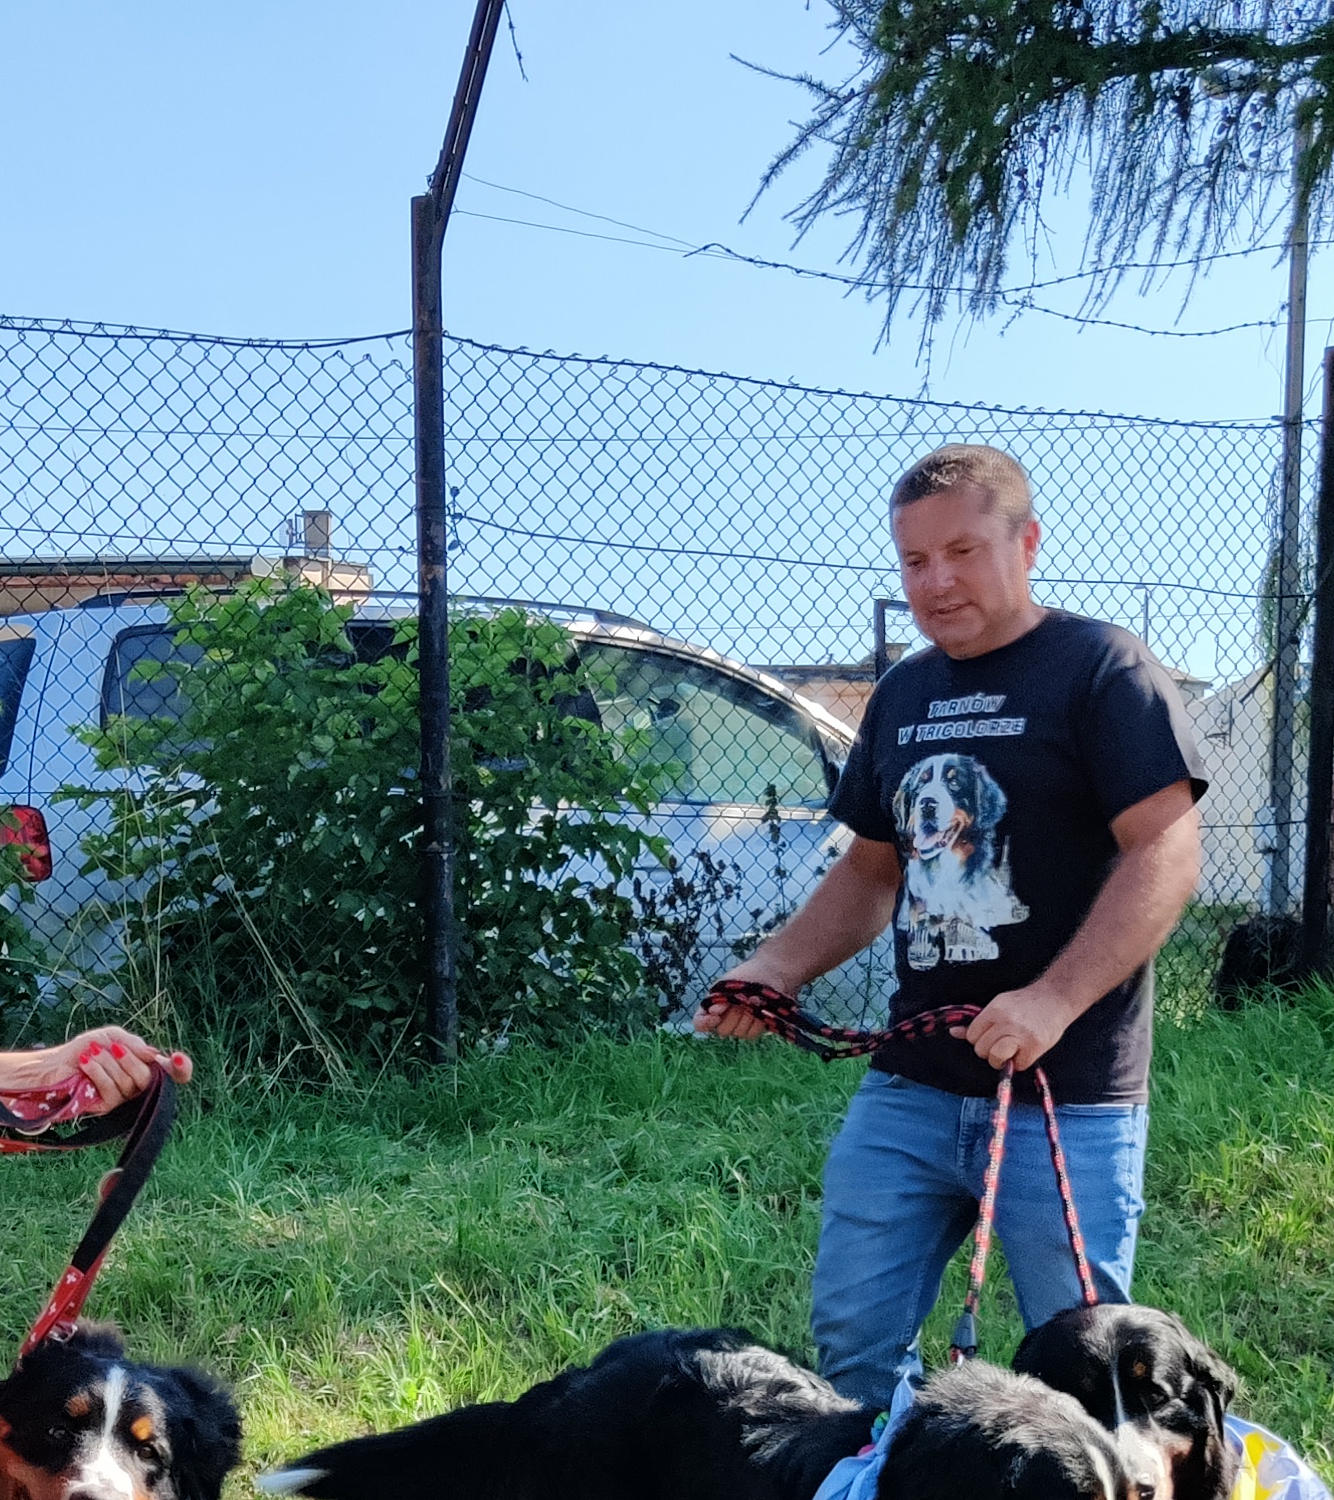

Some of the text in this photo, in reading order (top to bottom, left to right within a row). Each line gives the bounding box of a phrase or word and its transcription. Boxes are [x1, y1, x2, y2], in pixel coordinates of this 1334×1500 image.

[927, 692, 1007, 719] TARNÓW
[897, 718, 1027, 745] W TRICOLORZE
